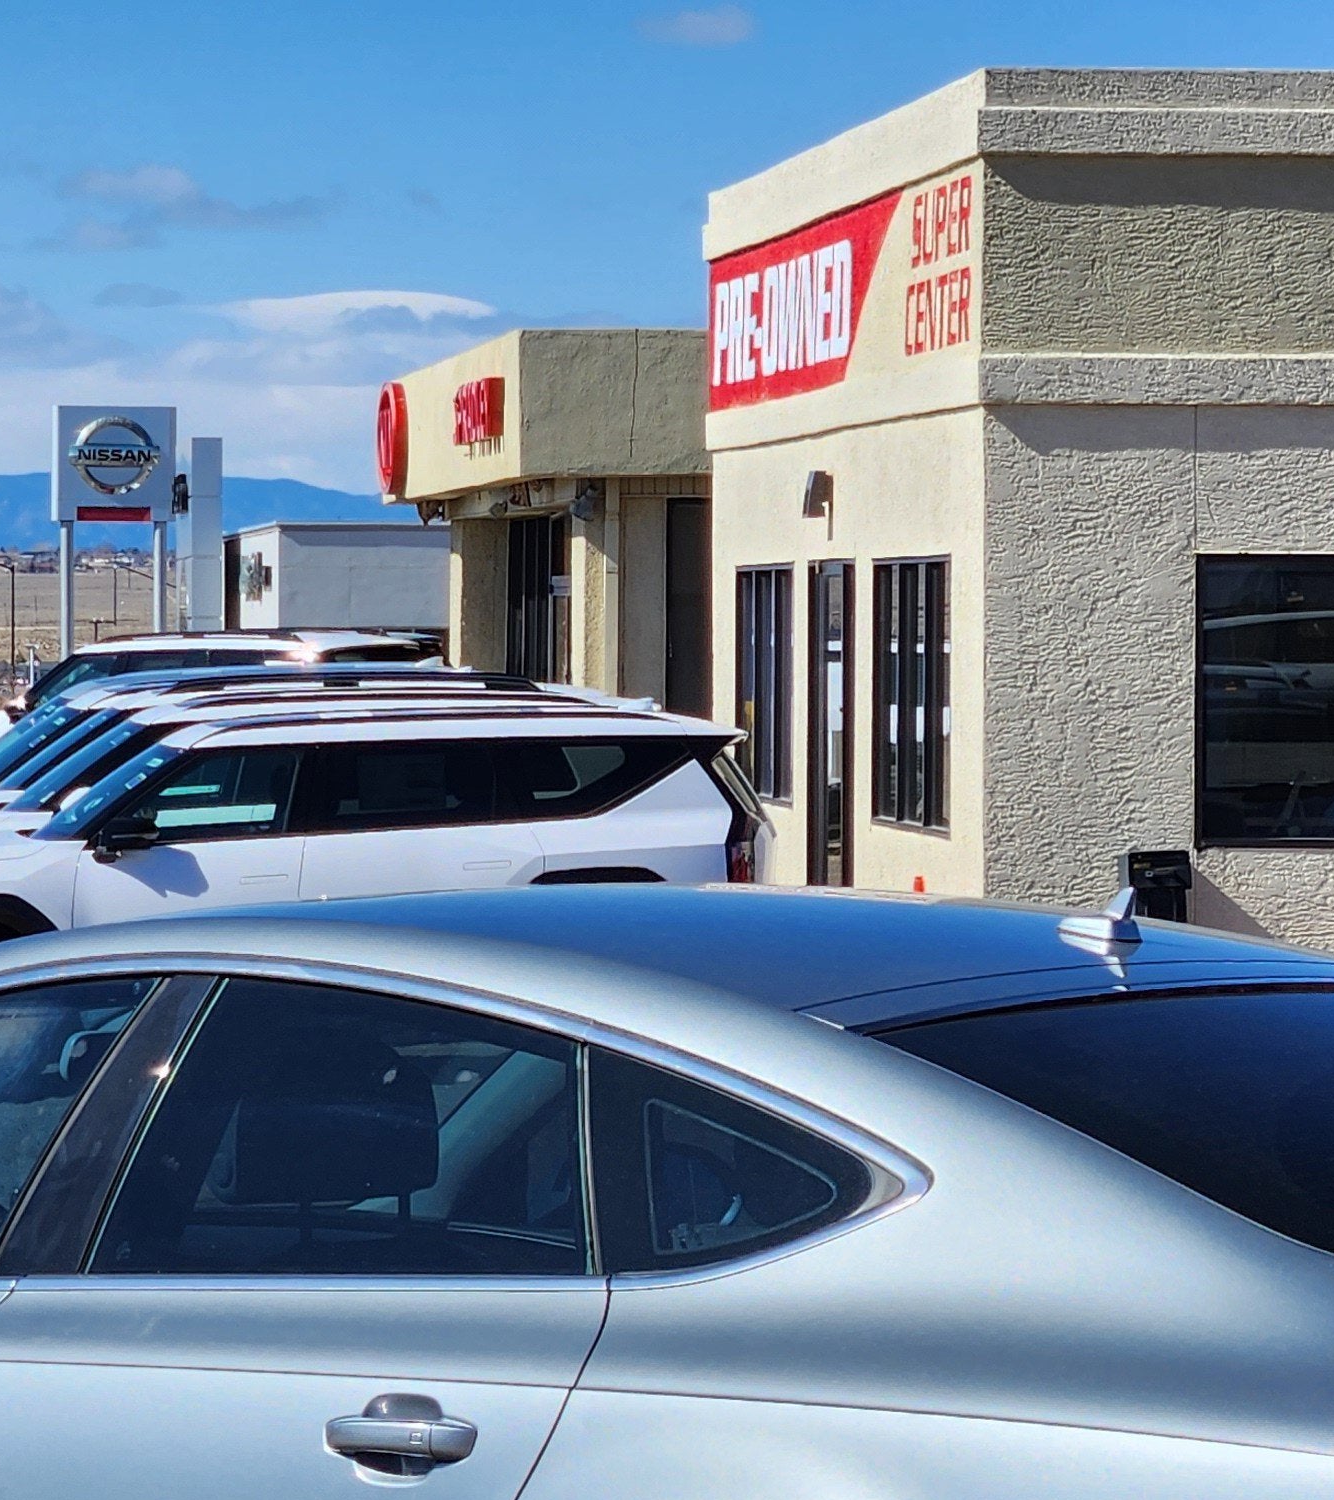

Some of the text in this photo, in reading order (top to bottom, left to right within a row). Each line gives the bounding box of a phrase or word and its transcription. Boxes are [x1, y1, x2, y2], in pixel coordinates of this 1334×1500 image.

[911, 175, 972, 269] SUPER
[712, 238, 852, 386] PRE-OWNED
[905, 266, 971, 357] CENTER
[77, 449, 151, 462] NISSAN
